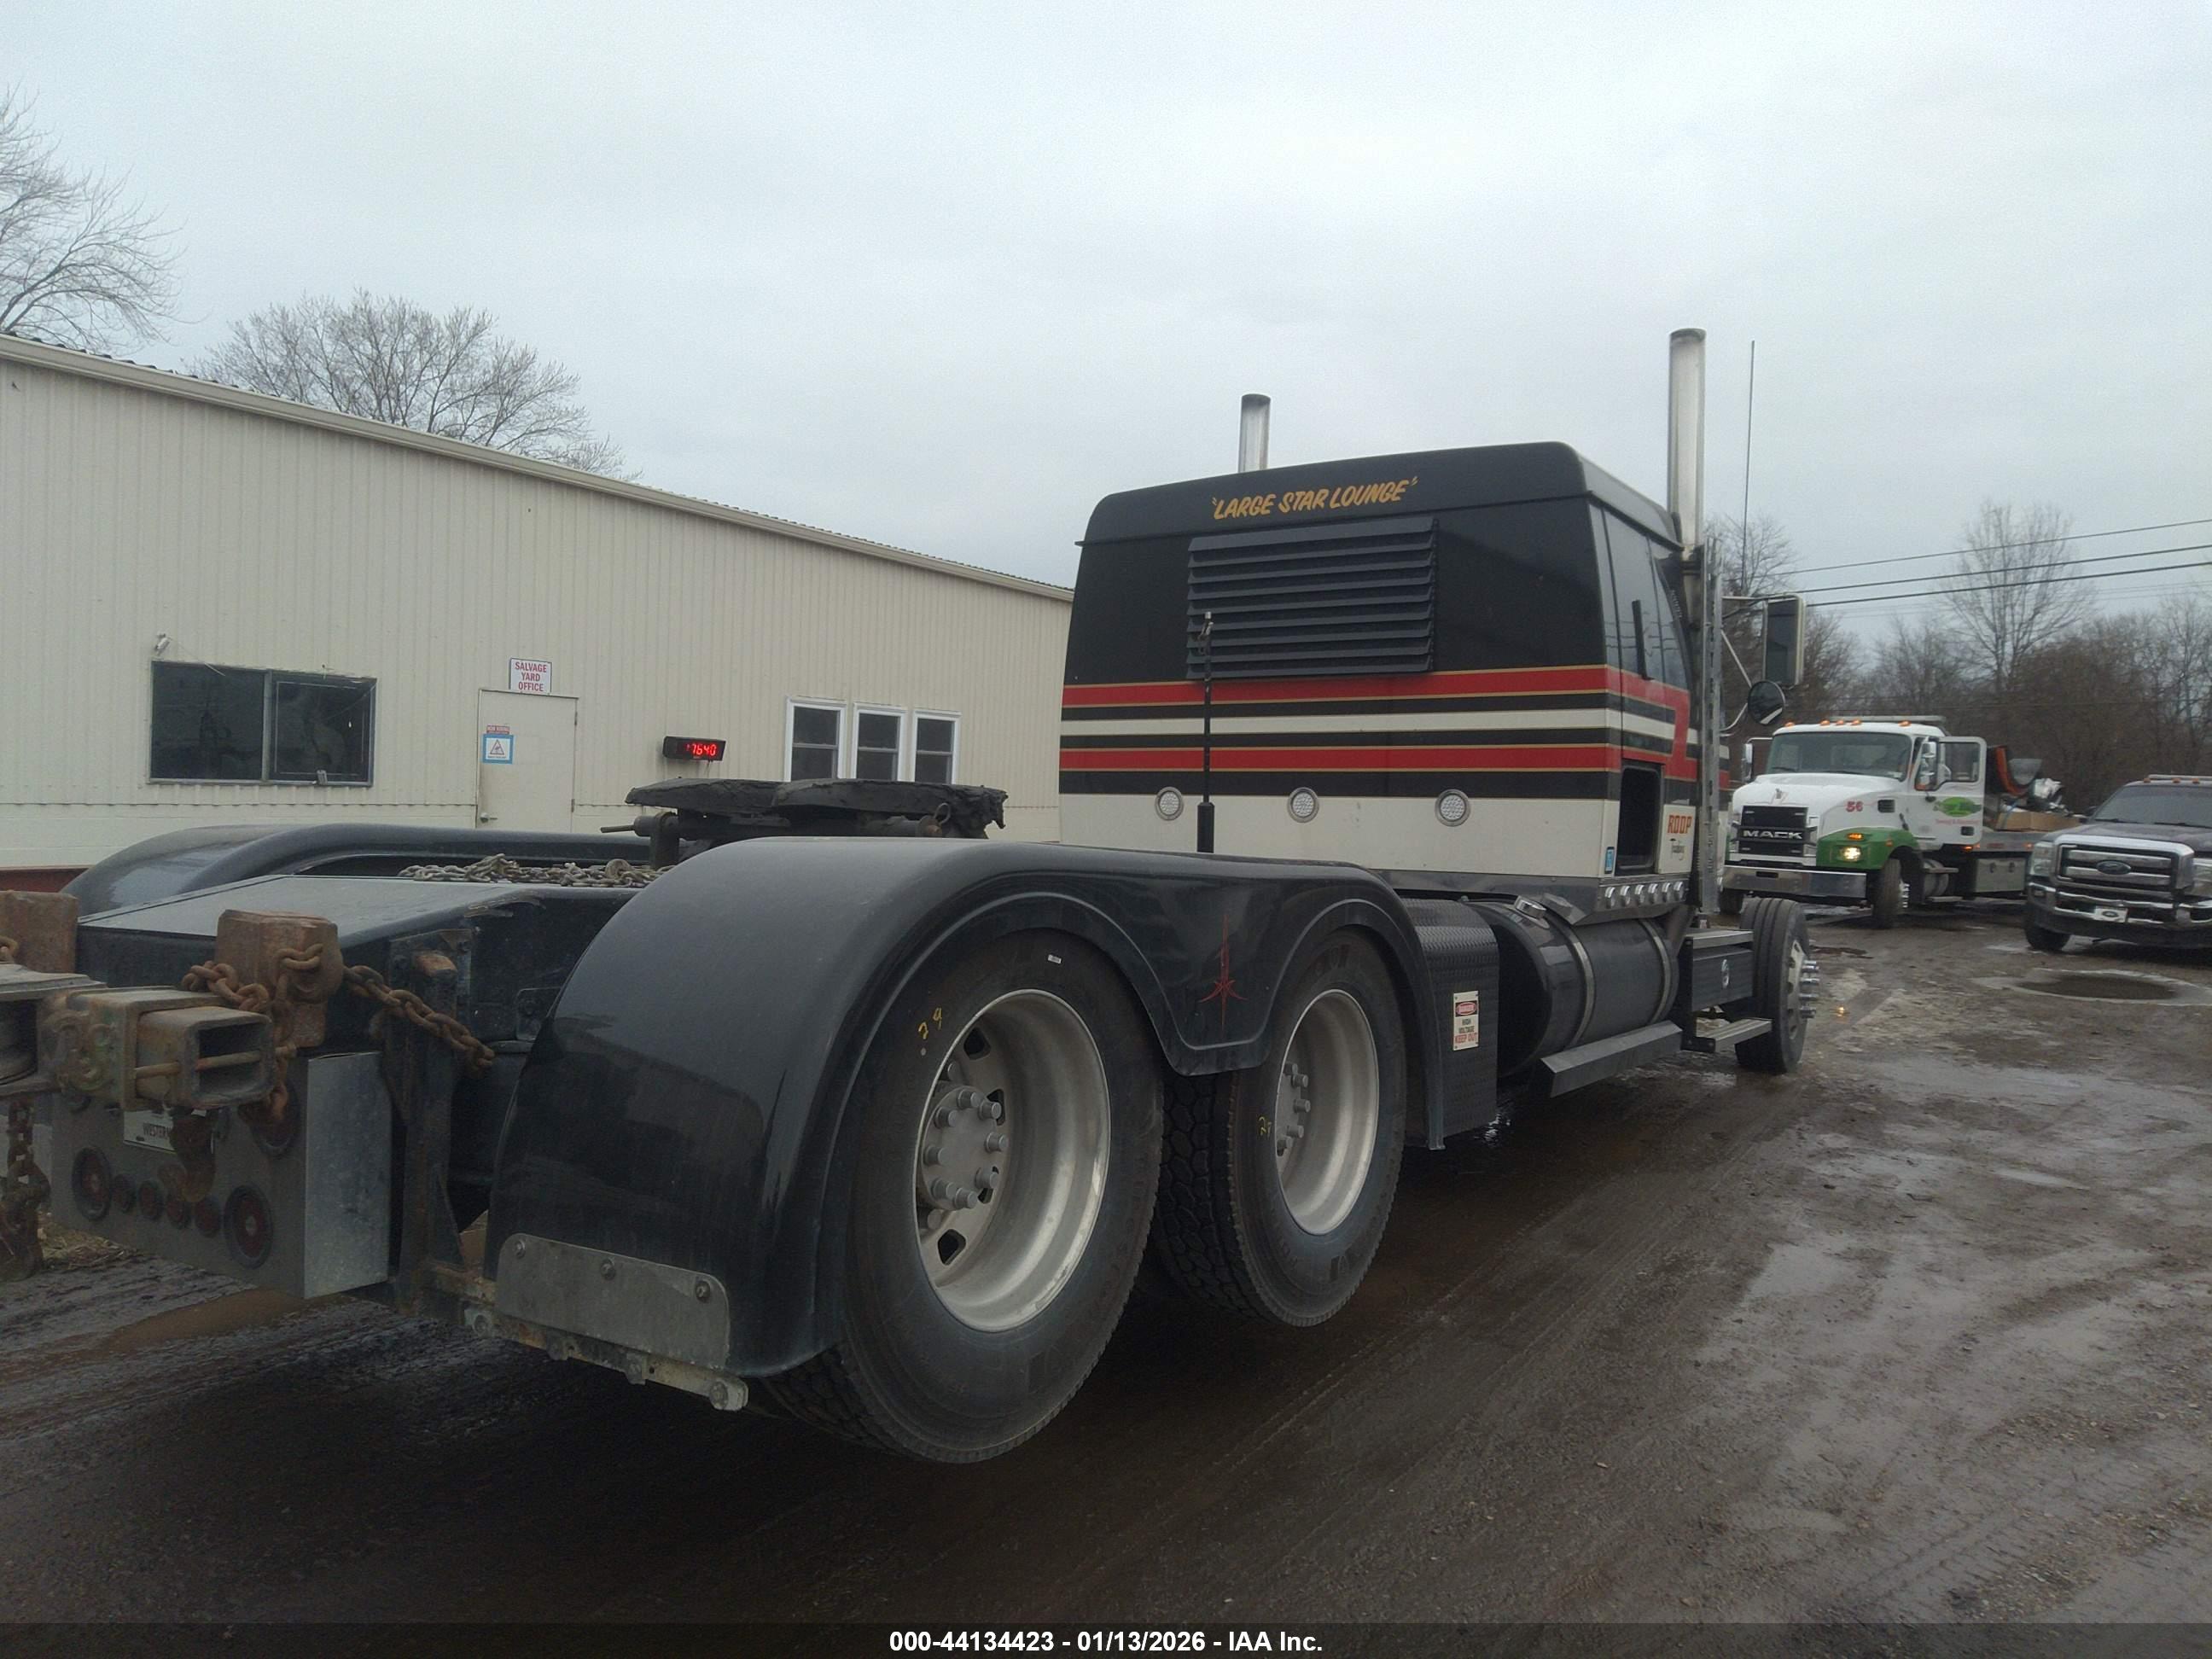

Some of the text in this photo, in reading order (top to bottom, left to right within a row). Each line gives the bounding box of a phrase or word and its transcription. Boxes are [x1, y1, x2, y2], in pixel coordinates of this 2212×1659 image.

[1278, 488, 1329, 513] STAR
[515, 661, 547, 672] SALVAGE
[521, 672, 540, 682] YARD
[518, 681, 544, 692] OFFICE
[1846, 800, 1864, 812] 56
[1667, 814, 1693, 834] ROOP
[1743, 830, 1803, 840] MACK
